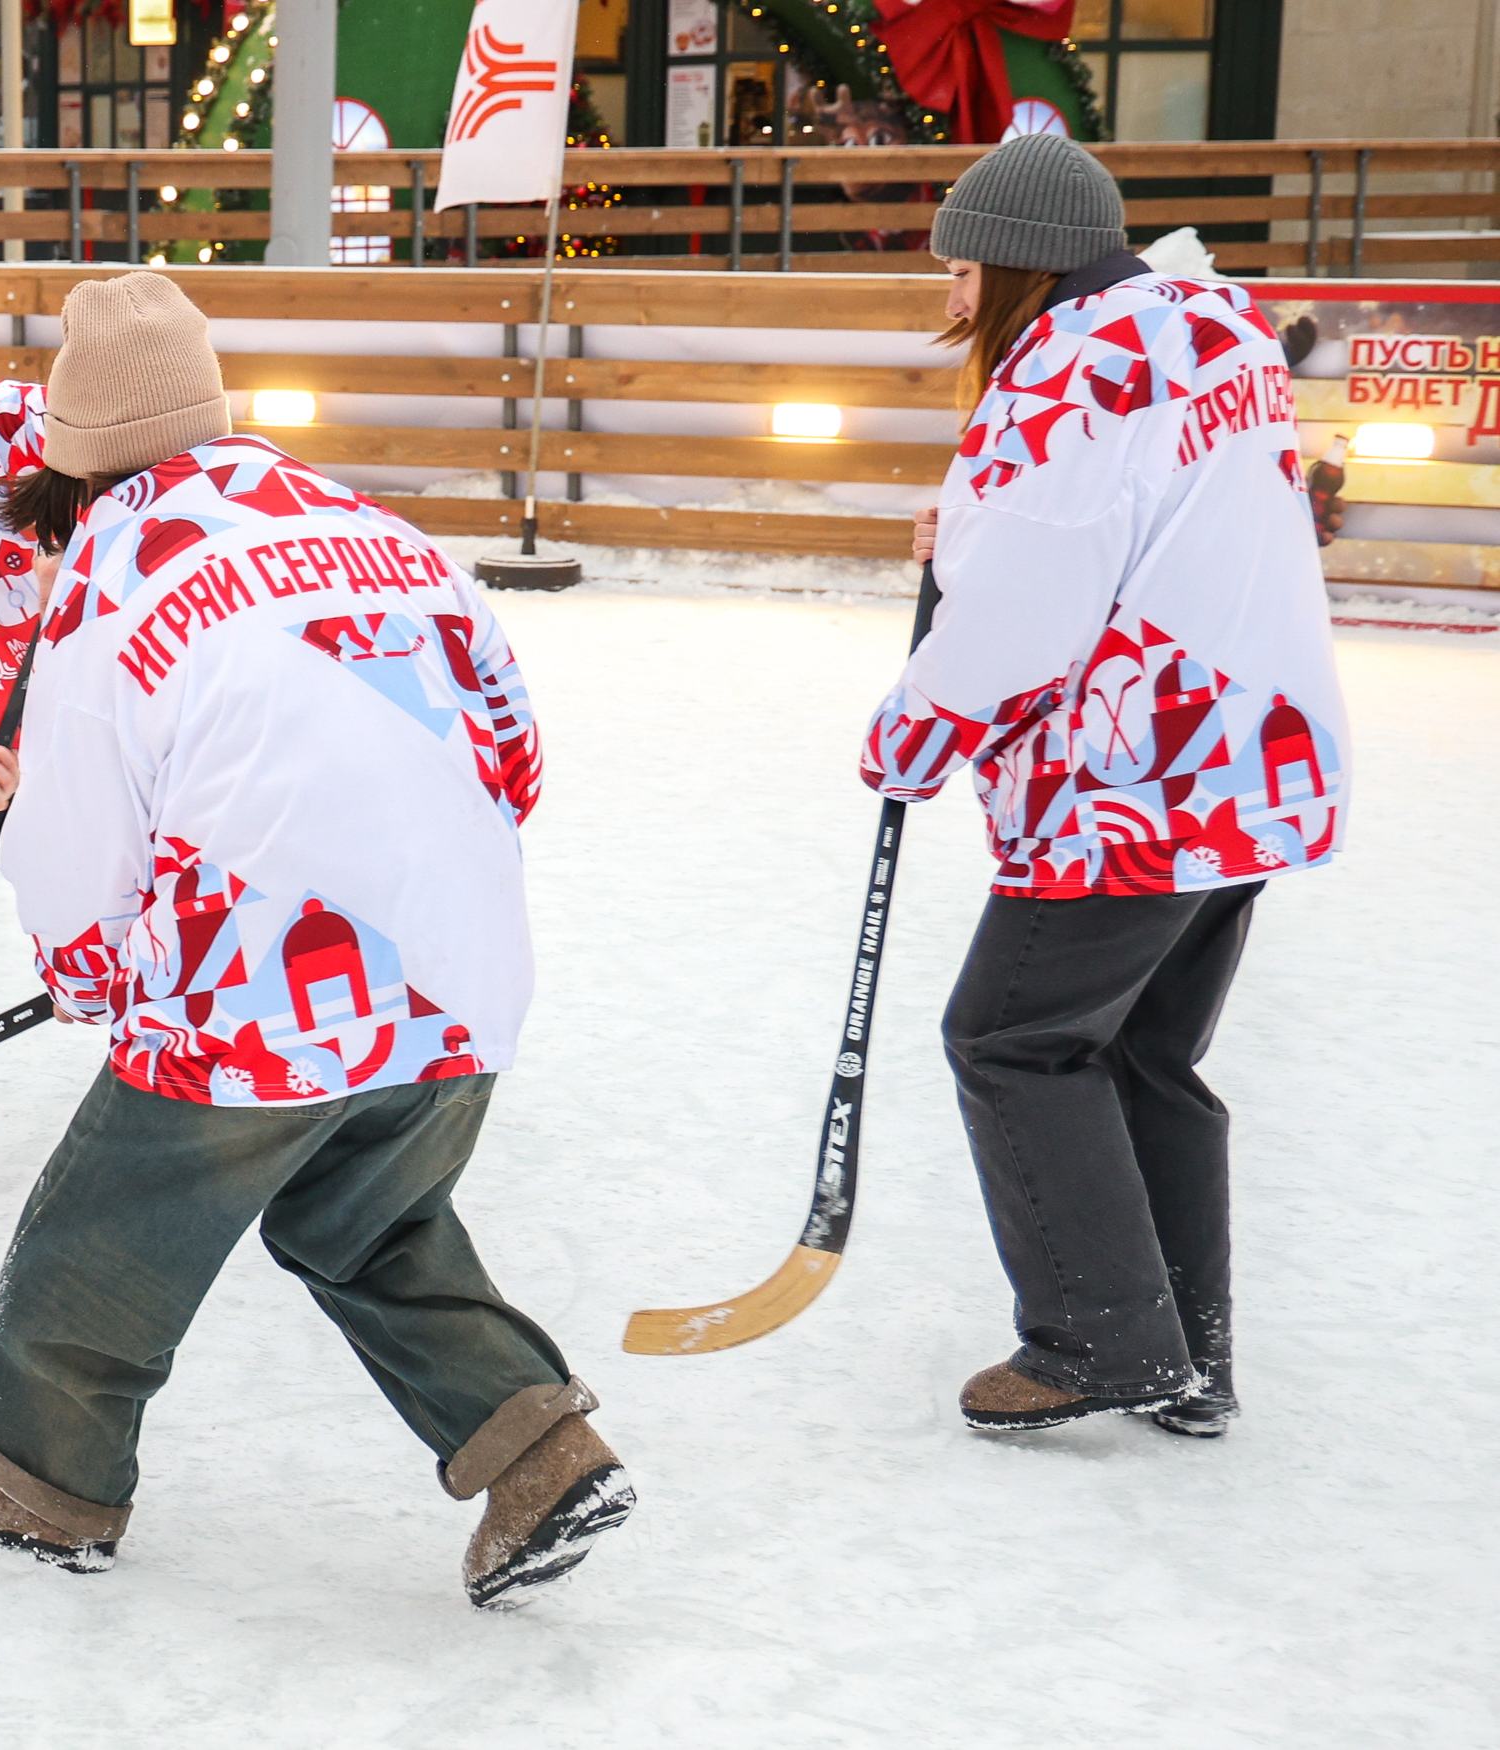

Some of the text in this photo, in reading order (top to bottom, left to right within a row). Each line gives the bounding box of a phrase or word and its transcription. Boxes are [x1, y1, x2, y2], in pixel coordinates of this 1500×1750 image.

[1350, 338, 1474, 369] ПУСТЬ
[1348, 377, 1468, 410] БУДЕТ
[822, 1096, 853, 1186] STEX
[845, 957, 875, 1042] ORANGE
[861, 908, 884, 954] HAIL
